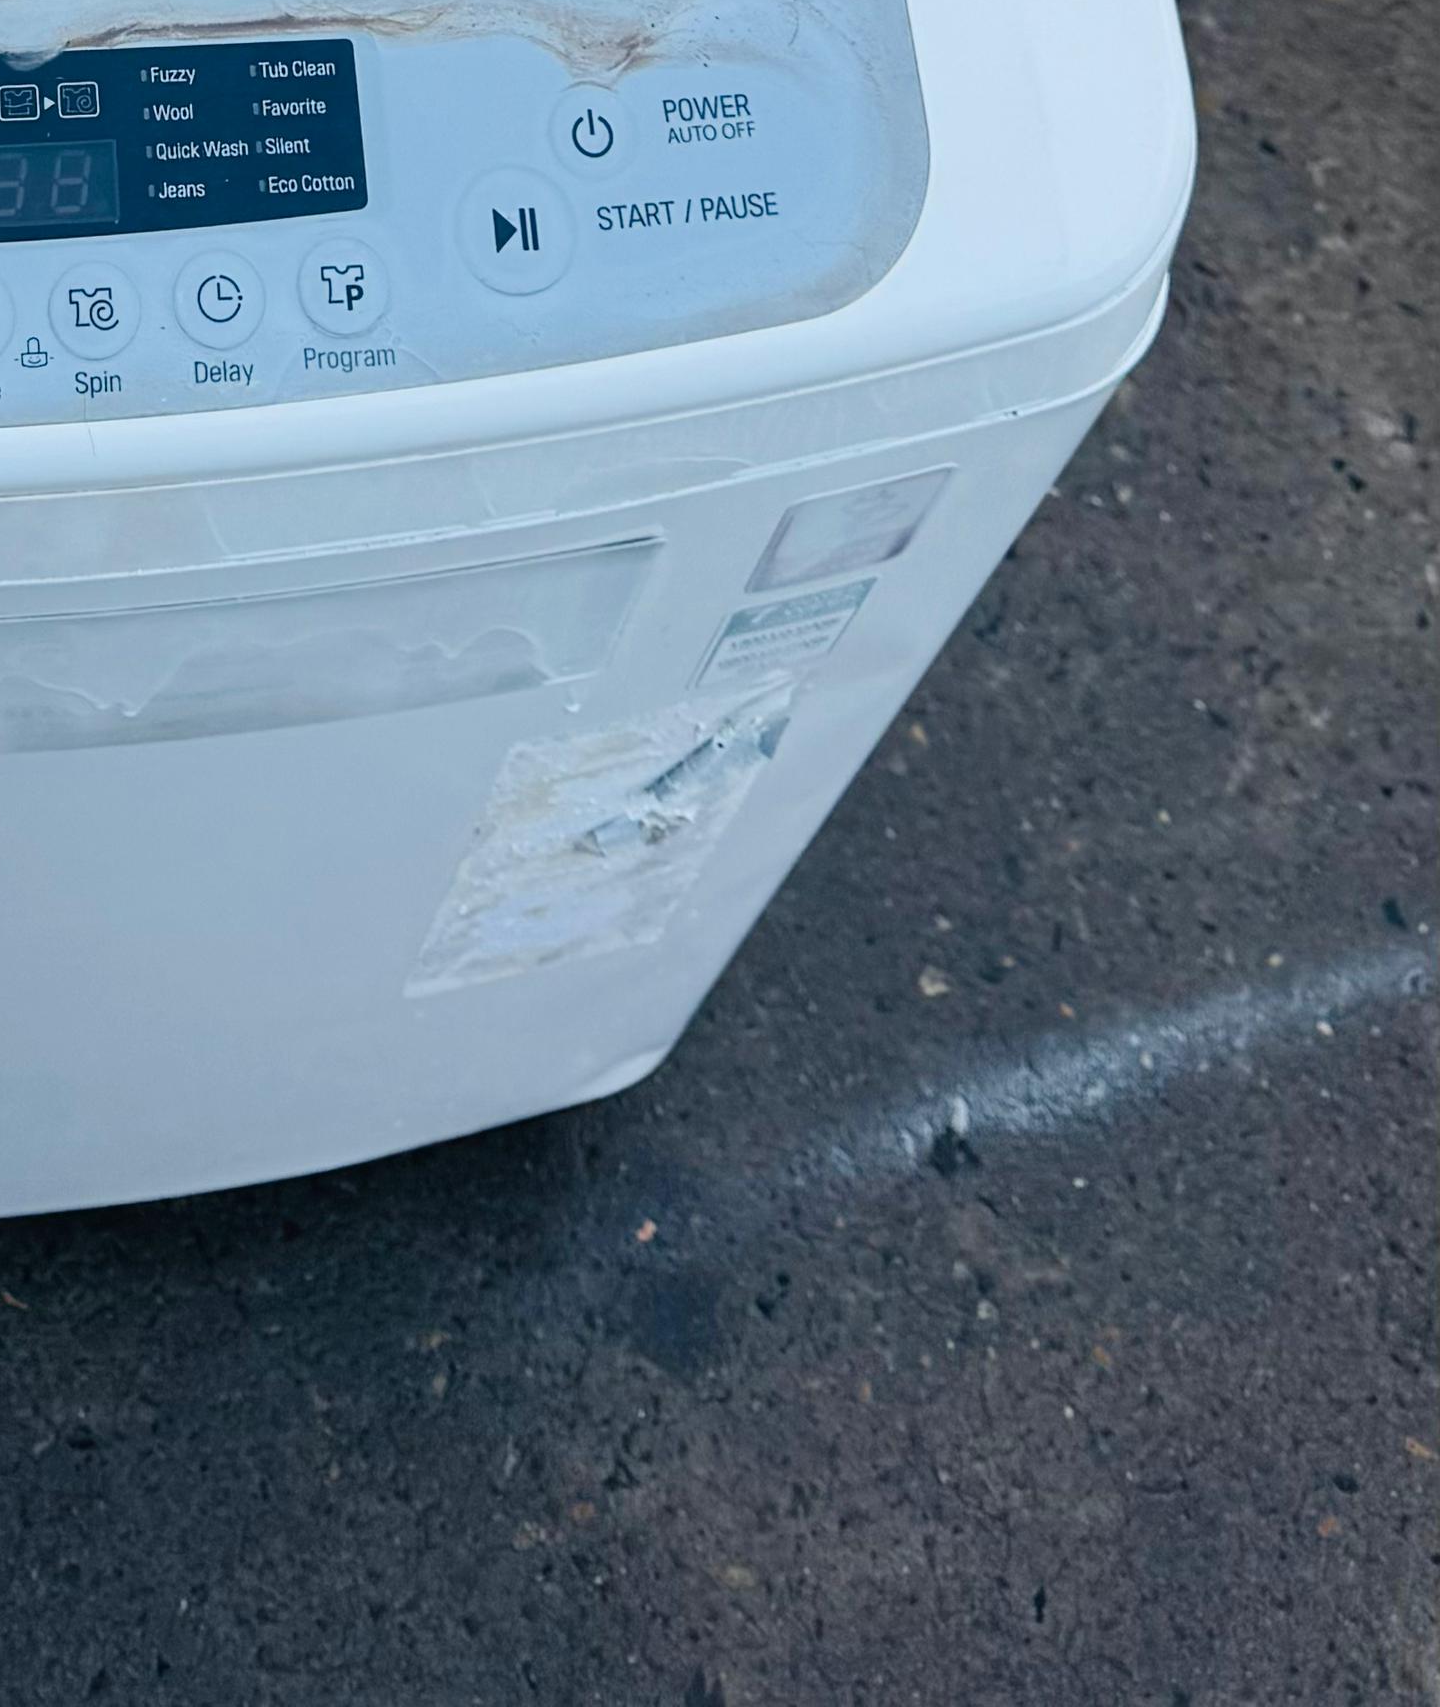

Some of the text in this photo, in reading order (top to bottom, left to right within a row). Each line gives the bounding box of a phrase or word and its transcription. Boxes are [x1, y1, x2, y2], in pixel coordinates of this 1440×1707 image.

[150, 67, 196, 85] Fuzzy
[258, 61, 336, 79] Tub Clean
[152, 103, 194, 121] Wool
[262, 98, 327, 116] Favorite
[662, 93, 752, 123] POWER
[668, 121, 756, 144] AUTO OFF
[156, 140, 249, 160] Quick Wash
[265, 137, 310, 155] Silent
[158, 182, 206, 199] Jeans
[268, 174, 355, 194] Eco Cotton
[596, 200, 675, 231] START
[700, 191, 779, 222] PAUSE
[303, 346, 397, 373] Program
[193, 359, 254, 386] Delay
[74, 371, 122, 398] Spin
